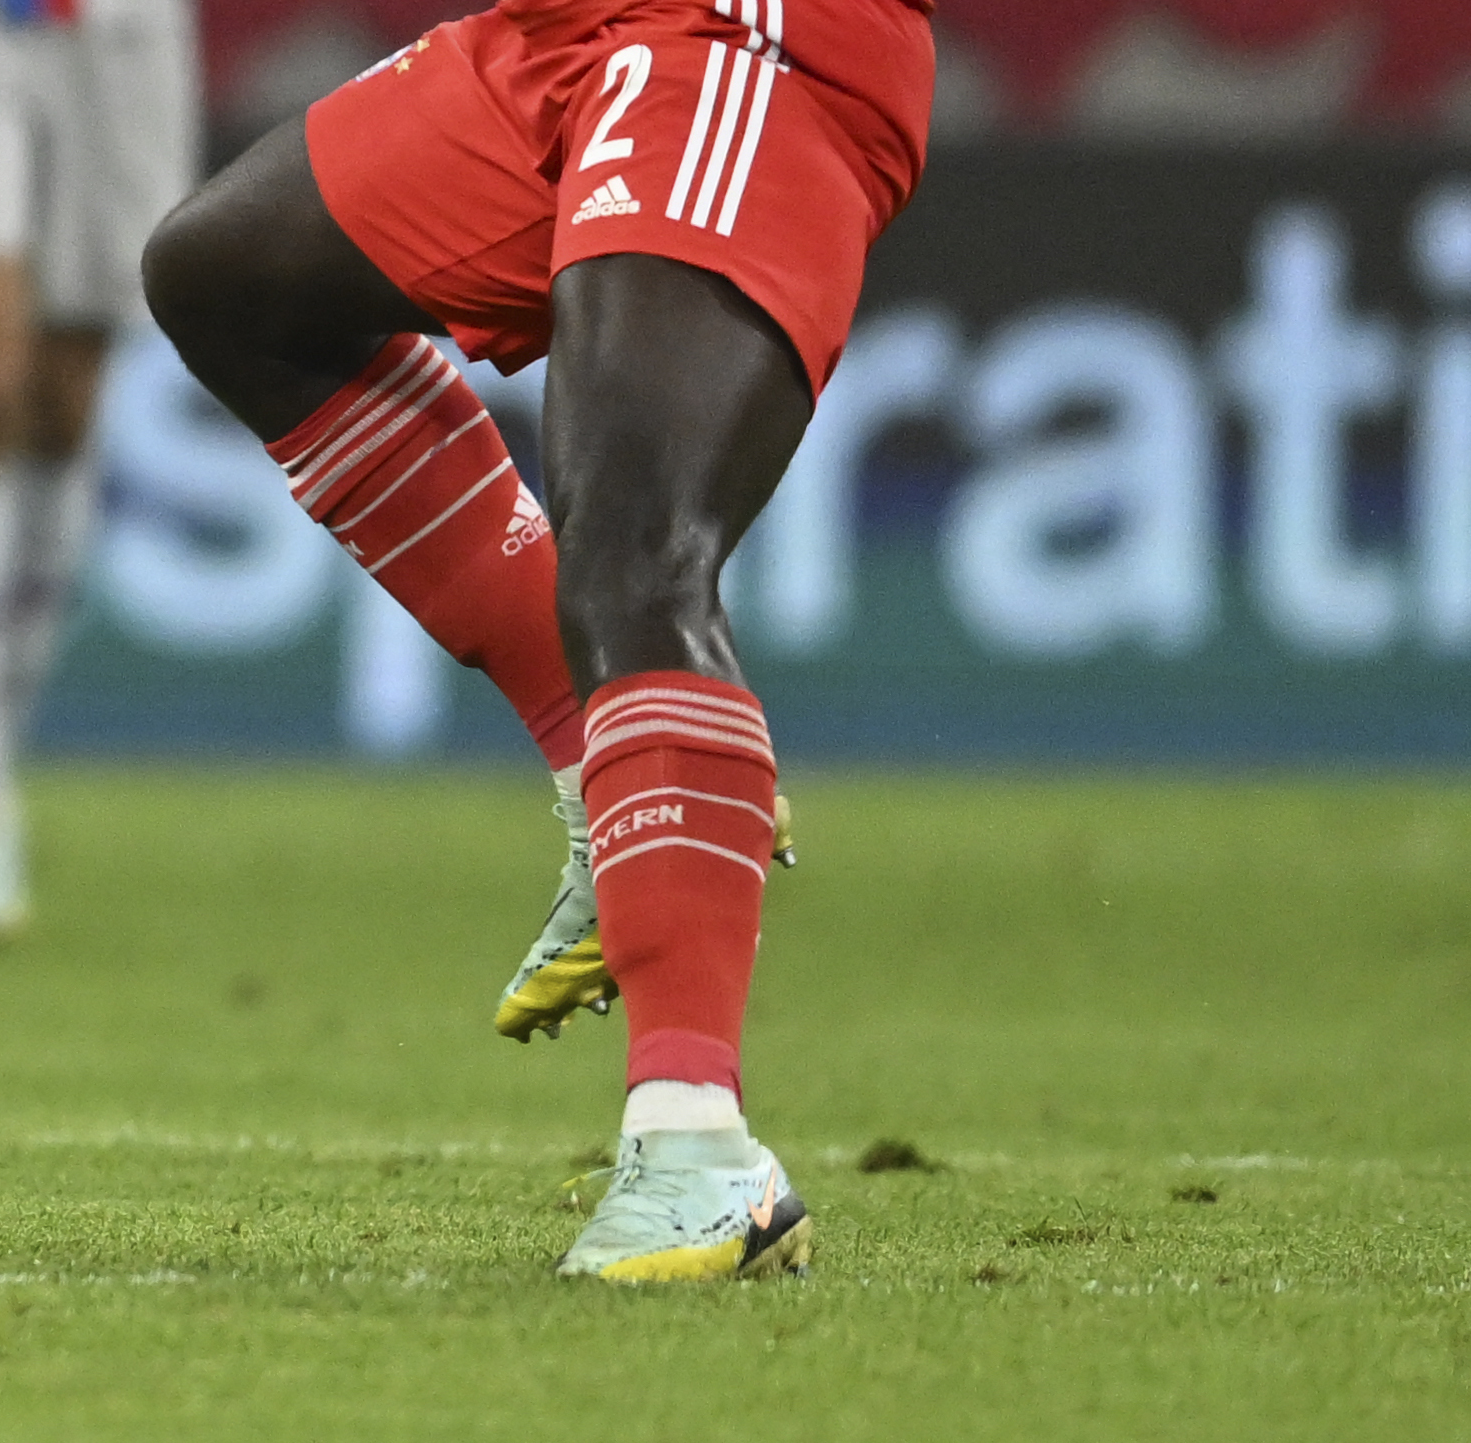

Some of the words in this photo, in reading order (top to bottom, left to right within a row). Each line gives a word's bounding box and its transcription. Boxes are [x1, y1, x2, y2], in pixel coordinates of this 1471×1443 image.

[577, 43, 654, 173] 2
[570, 199, 642, 226] adidas
[589, 804, 685, 857] YERN
